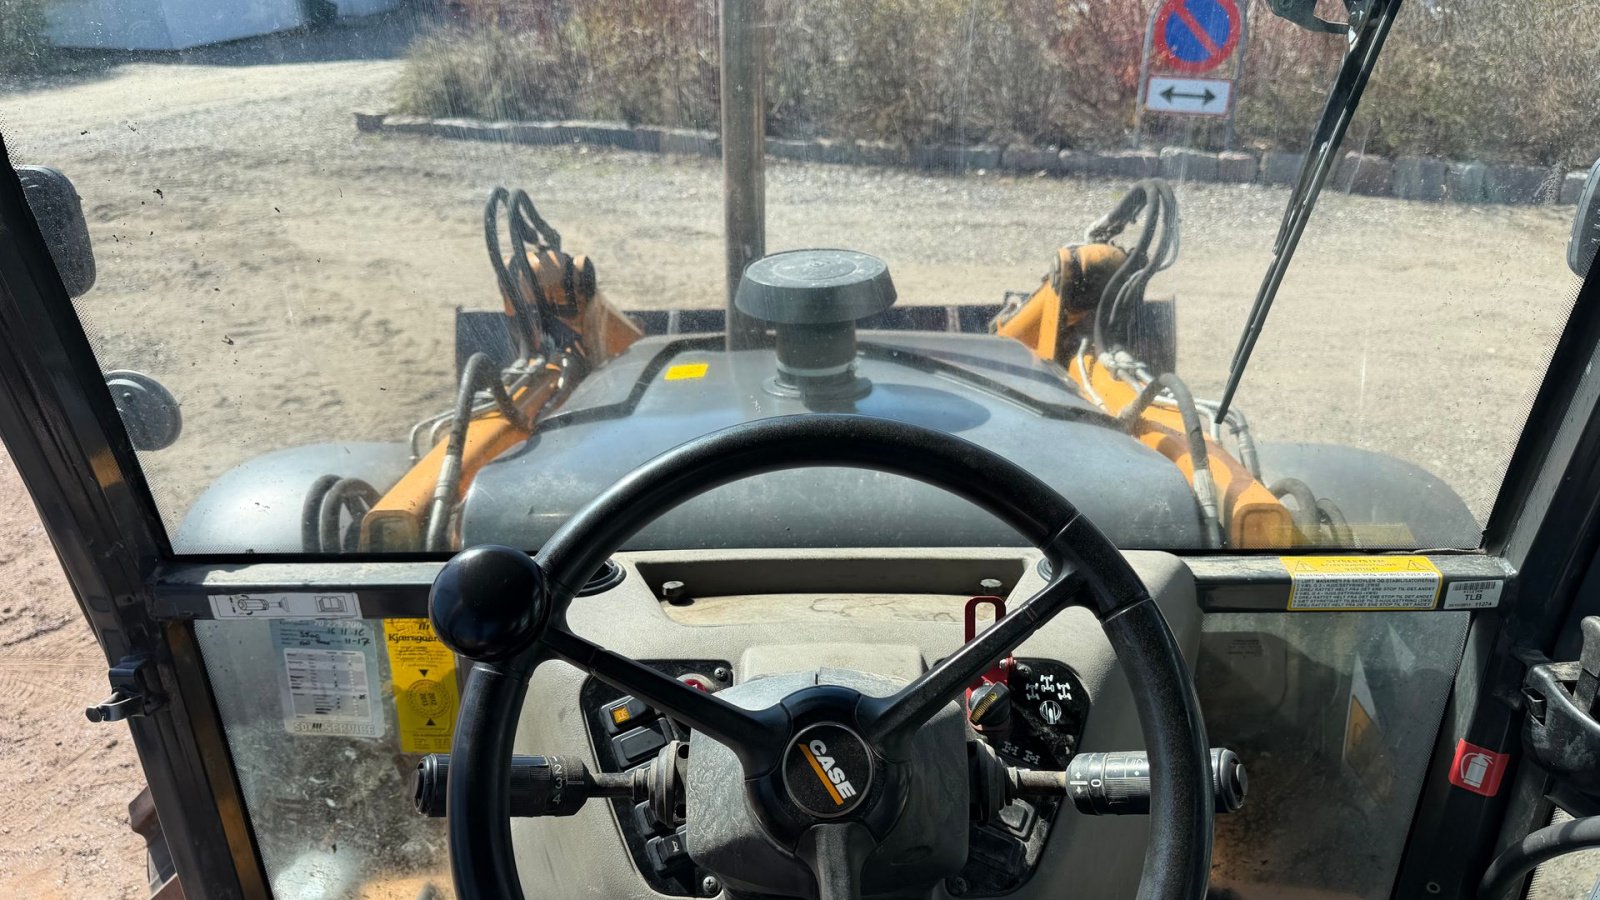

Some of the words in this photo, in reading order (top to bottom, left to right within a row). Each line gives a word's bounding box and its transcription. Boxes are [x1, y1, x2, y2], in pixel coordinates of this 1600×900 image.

[388, 633, 441, 644] Kjærsgaar
[554, 764, 562, 774] 2
[810, 740, 856, 799] CASE
[554, 776, 562, 790] 3
[552, 793, 561, 805] 4
